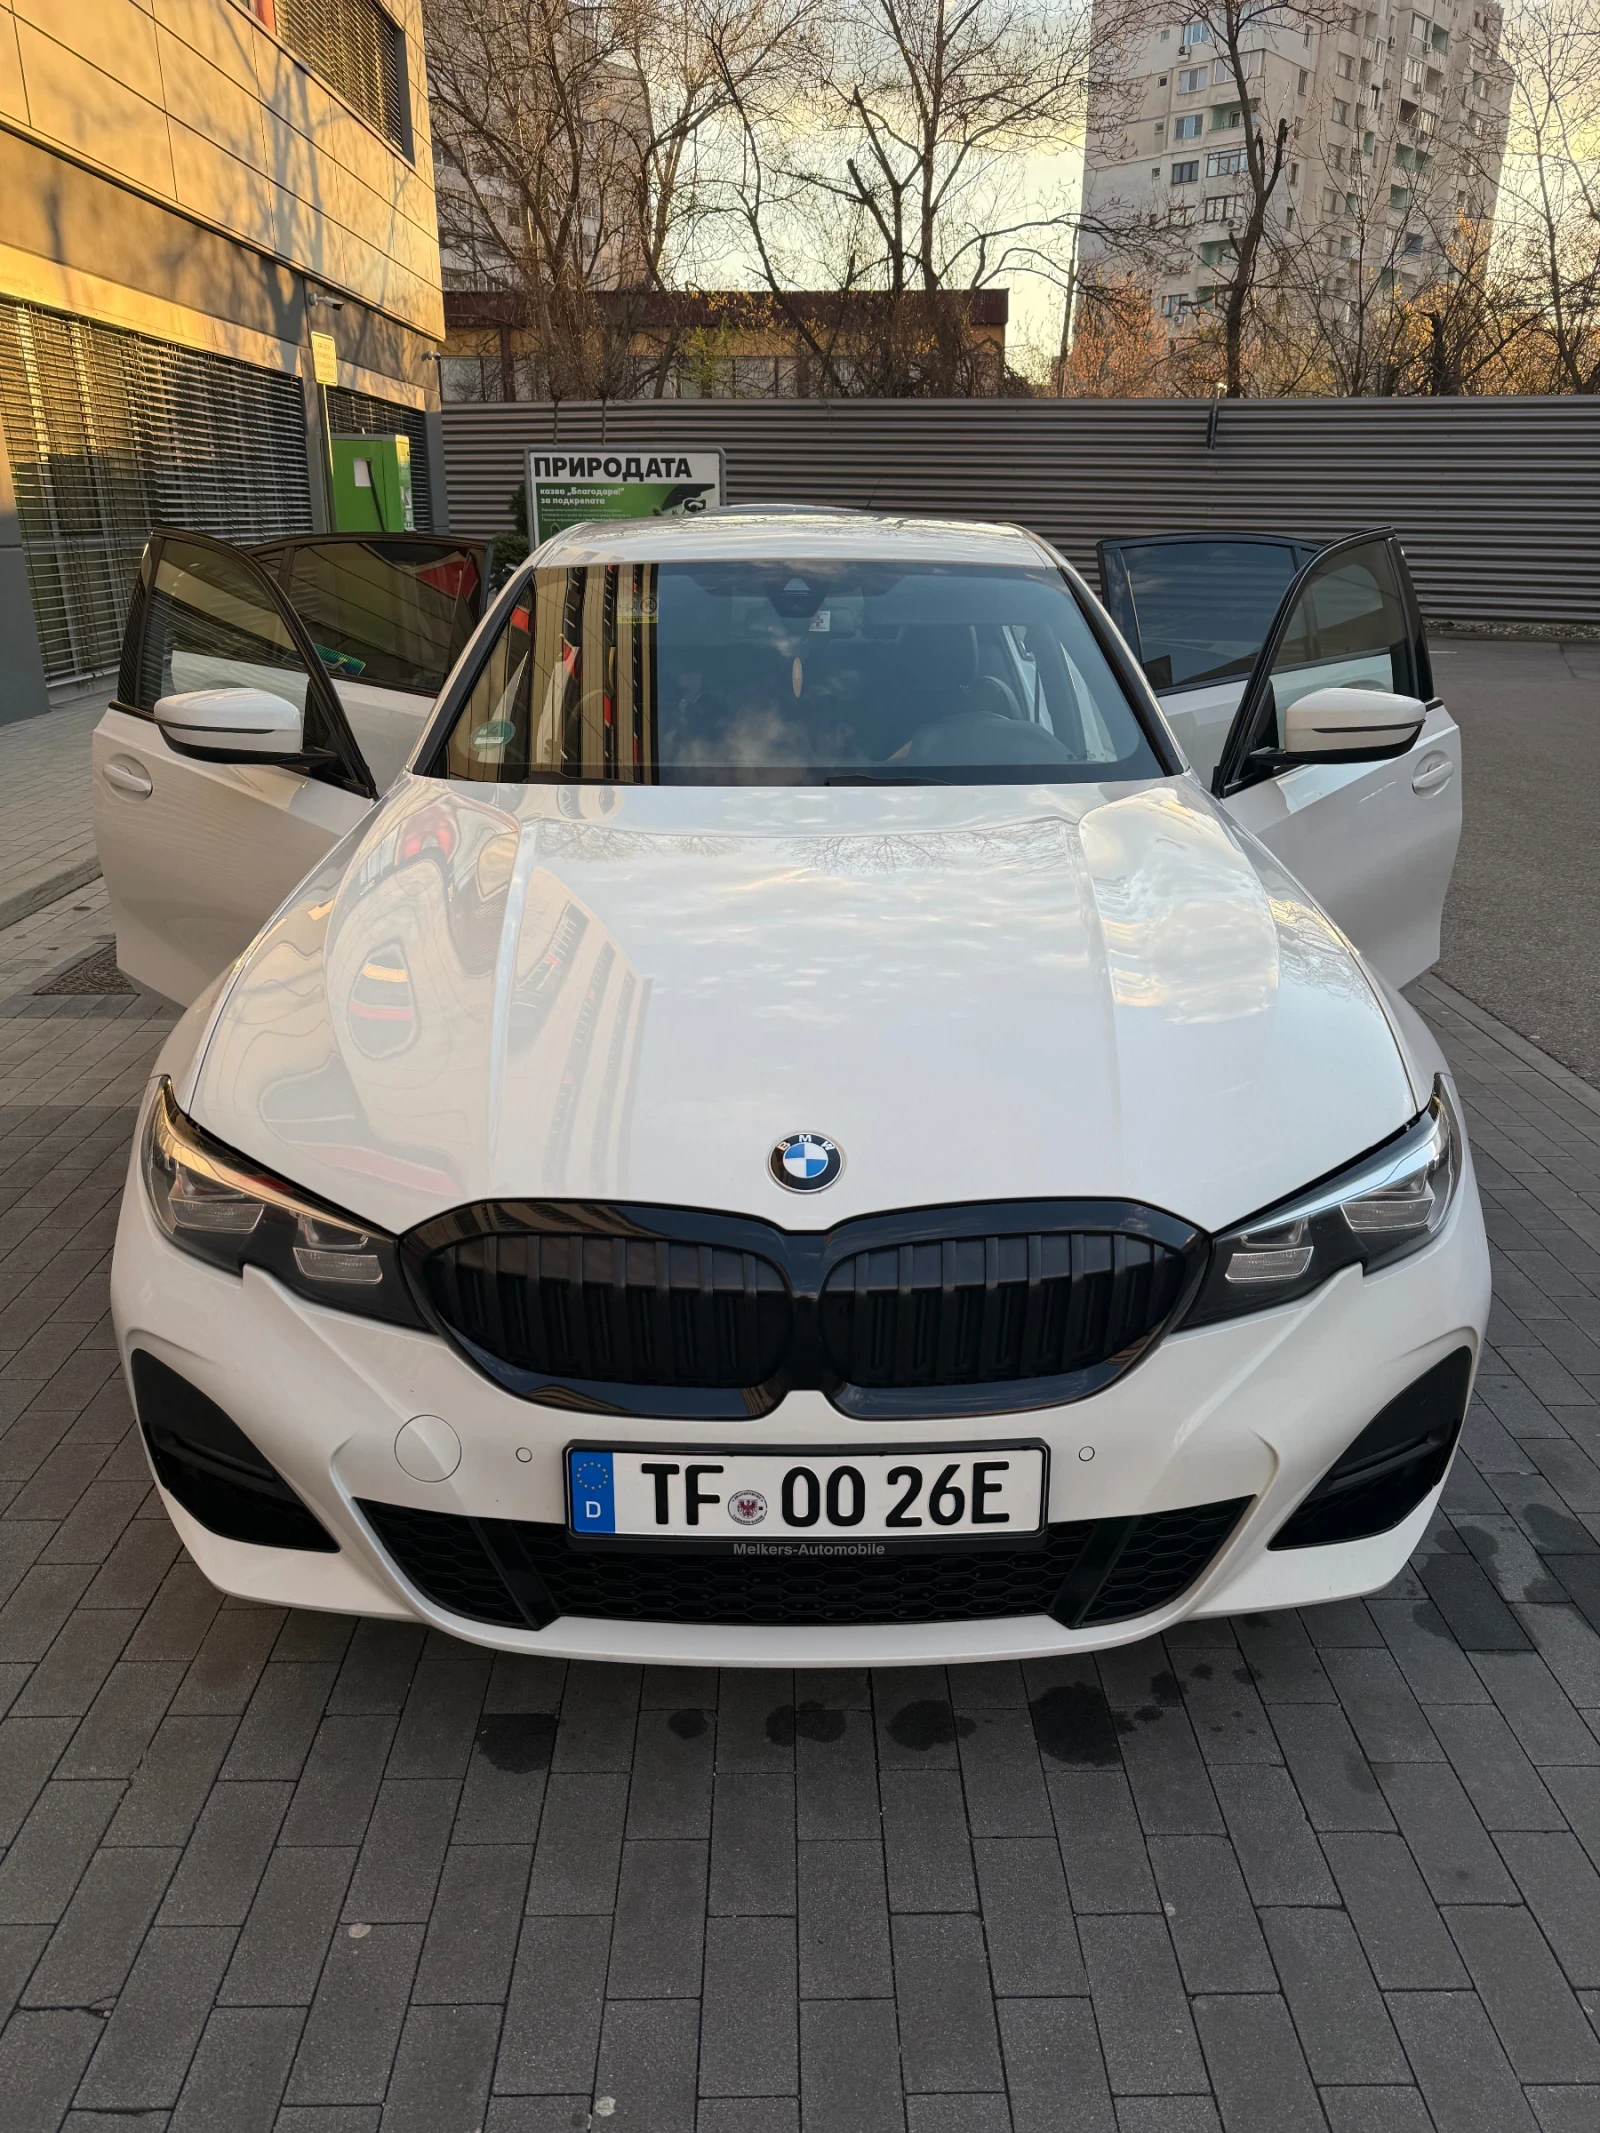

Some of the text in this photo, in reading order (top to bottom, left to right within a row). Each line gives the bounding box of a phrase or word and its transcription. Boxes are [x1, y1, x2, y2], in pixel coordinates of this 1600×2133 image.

[534, 457, 692, 482] ПРИРОДАТА
[552, 497, 605, 506] подкрепата
[776, 1134, 836, 1151] BMW
[641, 1462, 724, 1526] TF
[886, 1460, 1010, 1528] 26E
[586, 1501, 602, 1519] D
[733, 1543, 886, 1557] Melkers-Automobile
